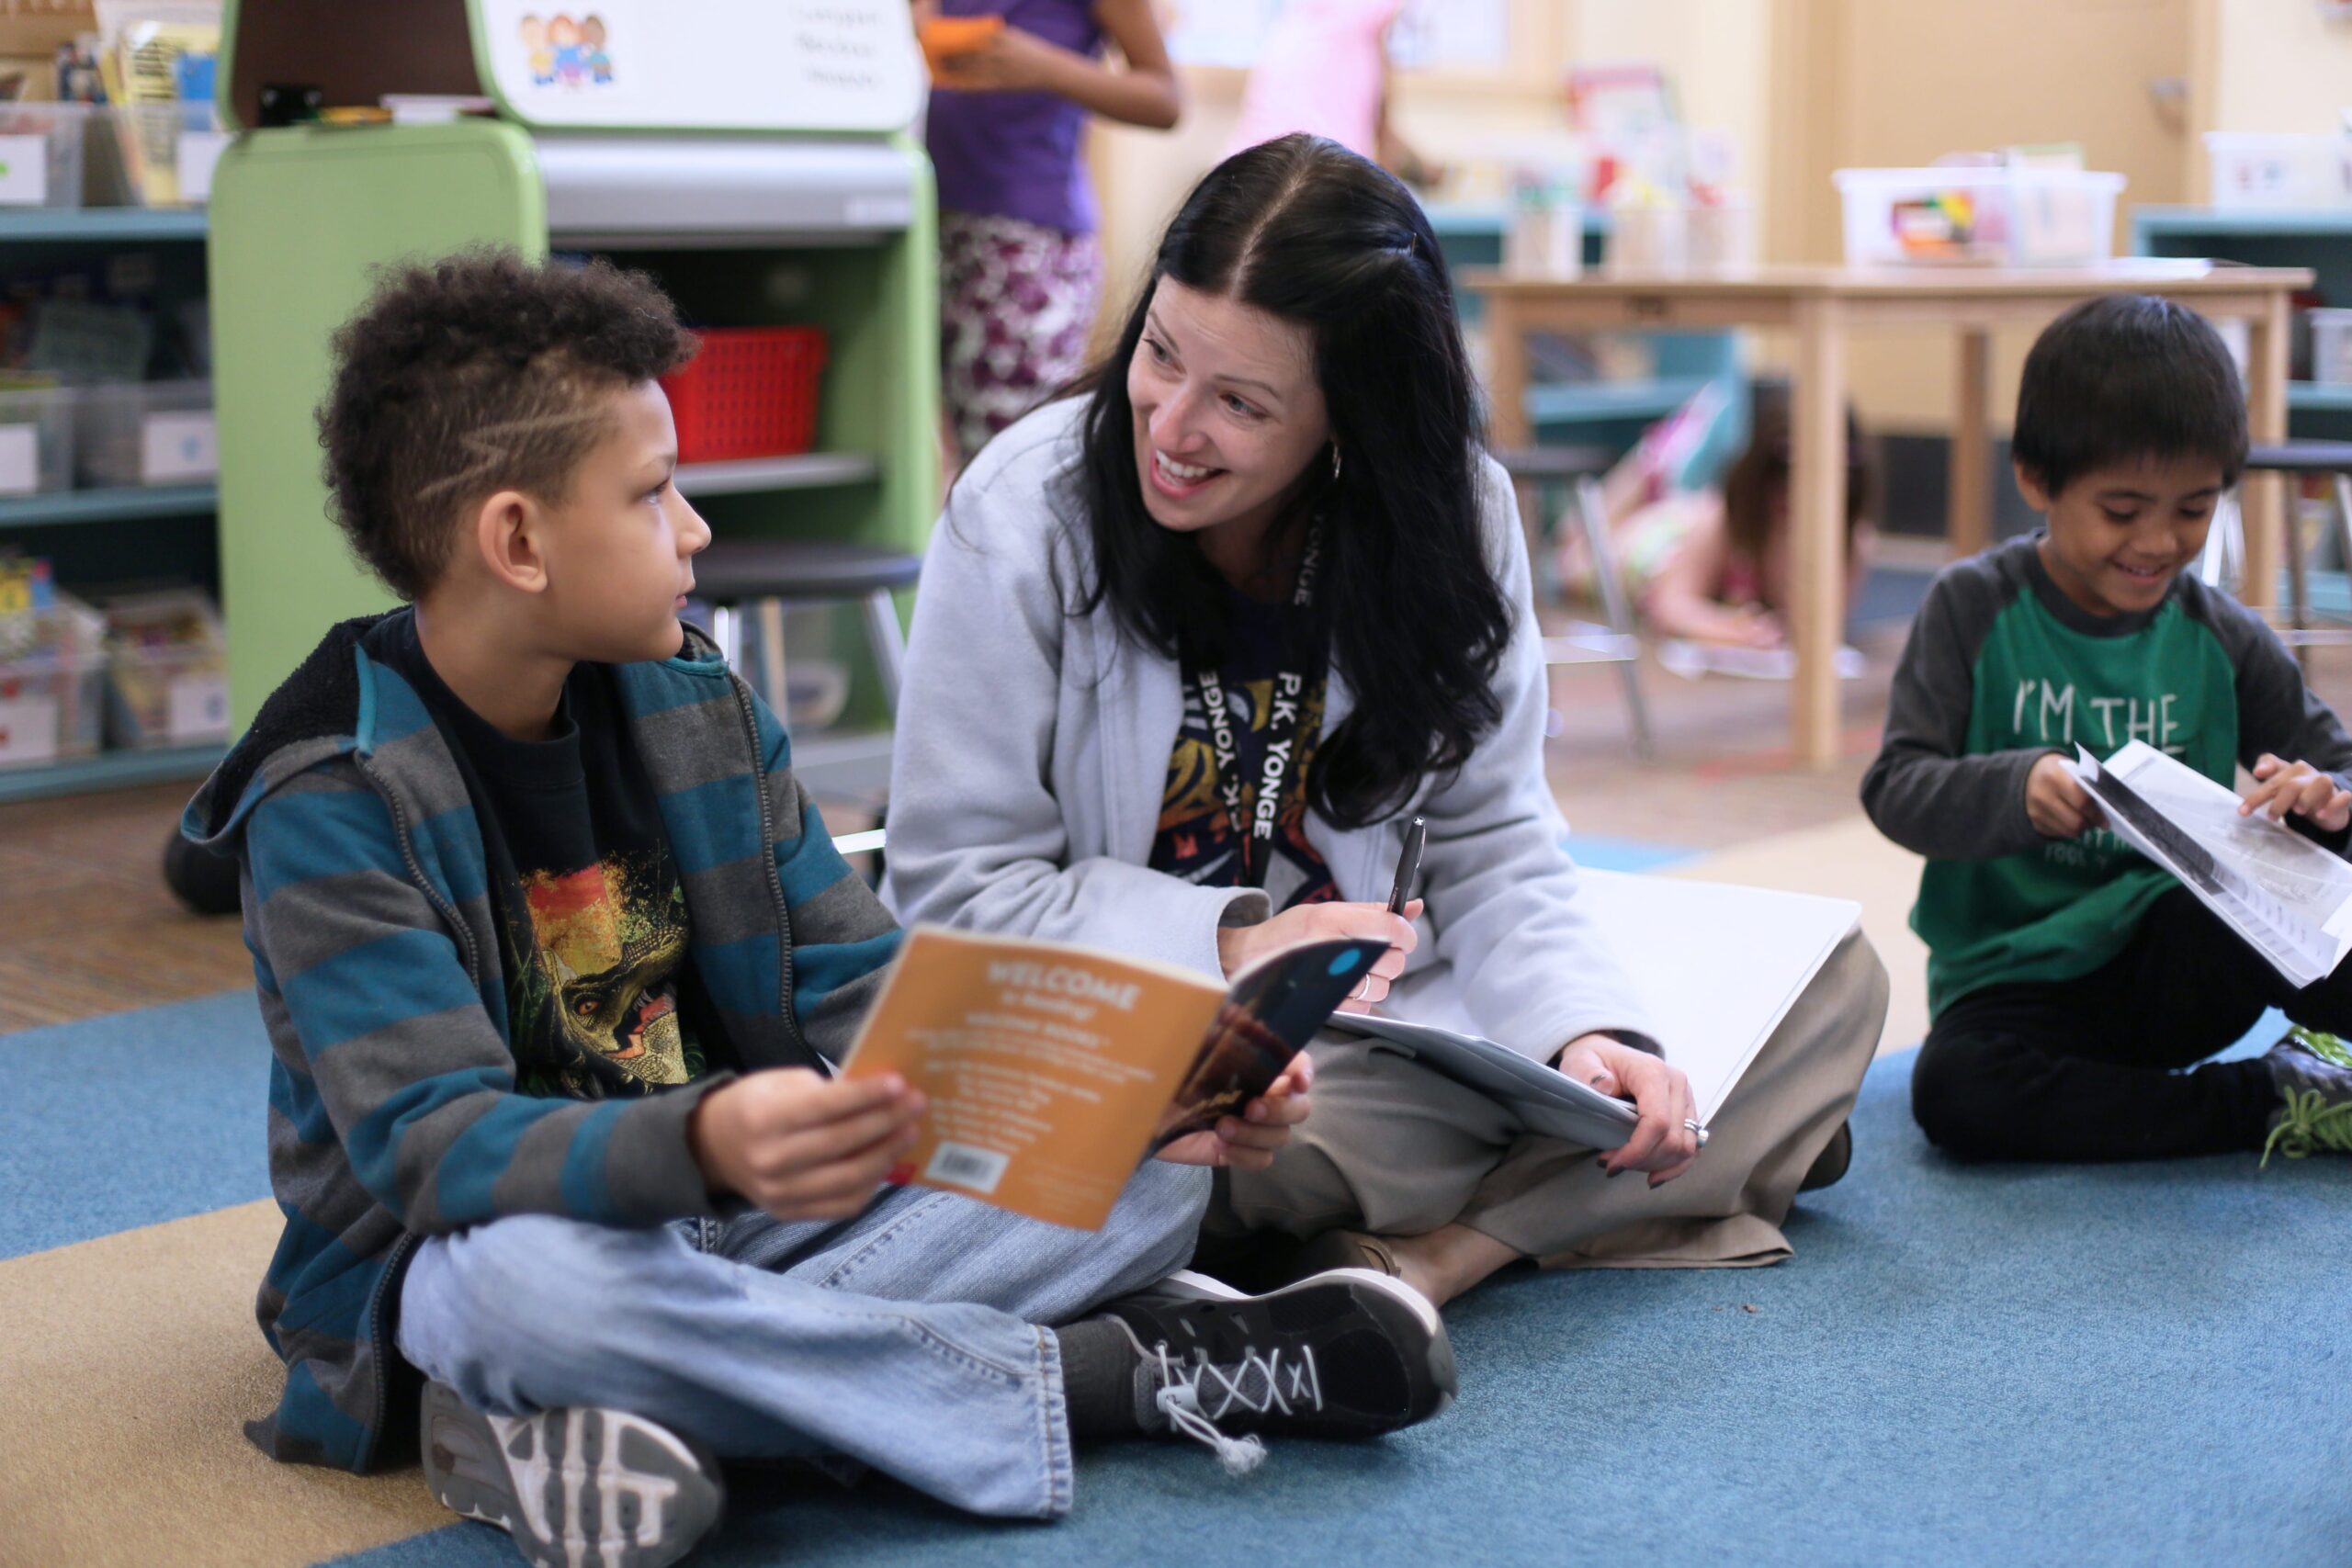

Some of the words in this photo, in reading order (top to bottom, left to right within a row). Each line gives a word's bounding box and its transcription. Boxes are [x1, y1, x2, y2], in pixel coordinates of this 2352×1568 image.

[1198, 671, 1236, 770] YONGE
[1270, 671, 1302, 730] P.K.
[2013, 678, 2075, 745] I'M
[2089, 694, 2185, 754] THE
[1253, 739, 1293, 840] YONGE
[988, 961, 1141, 1010] WELCOME
